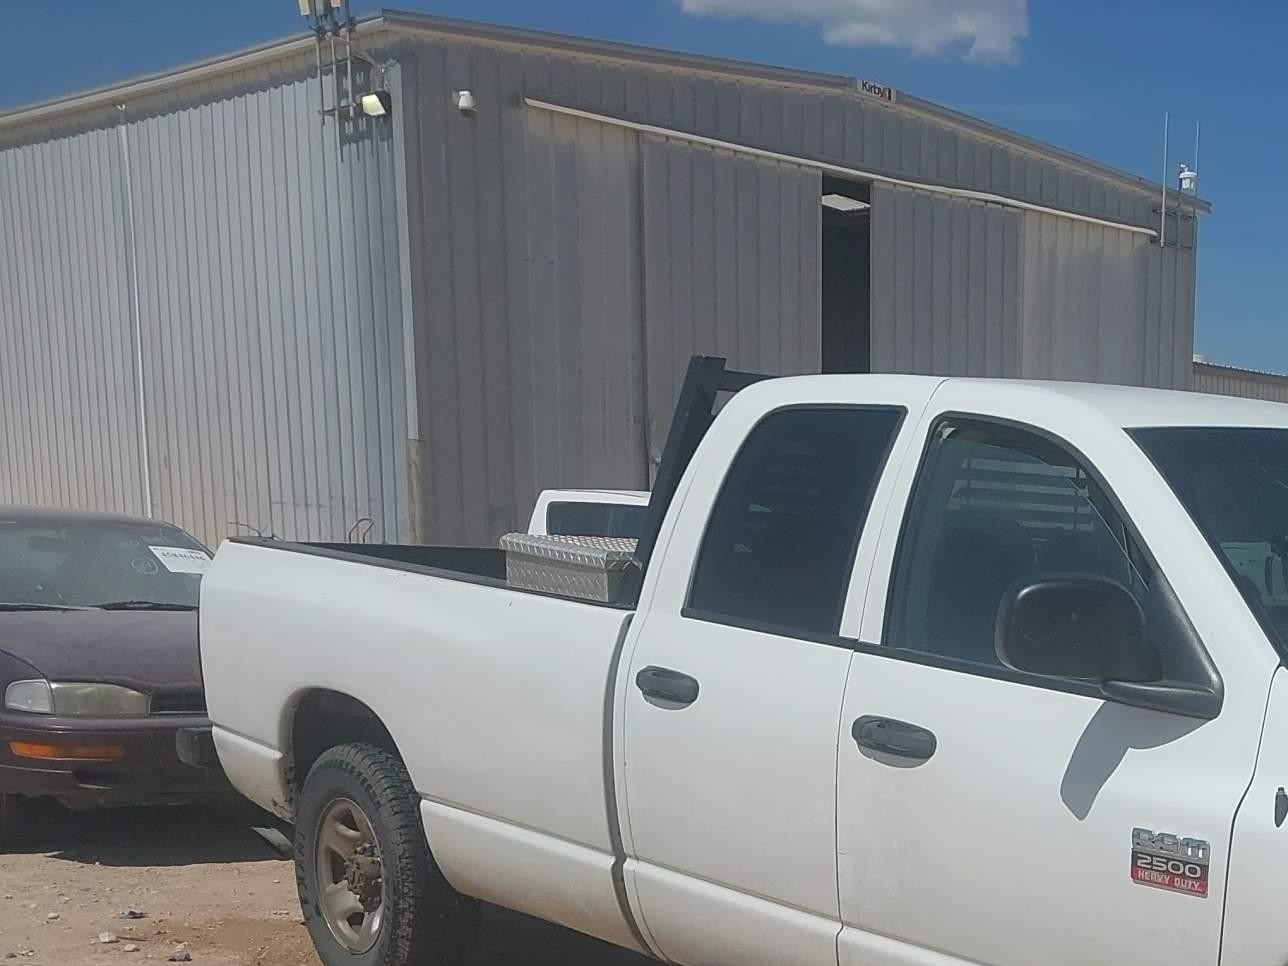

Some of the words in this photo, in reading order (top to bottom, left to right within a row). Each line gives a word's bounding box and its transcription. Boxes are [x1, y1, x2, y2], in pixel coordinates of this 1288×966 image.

[861, 80, 884, 98] Kirby
[1136, 853, 1202, 878] 2500
[1137, 870, 1171, 885] HEAVY
[1174, 877, 1200, 890] DUTY
